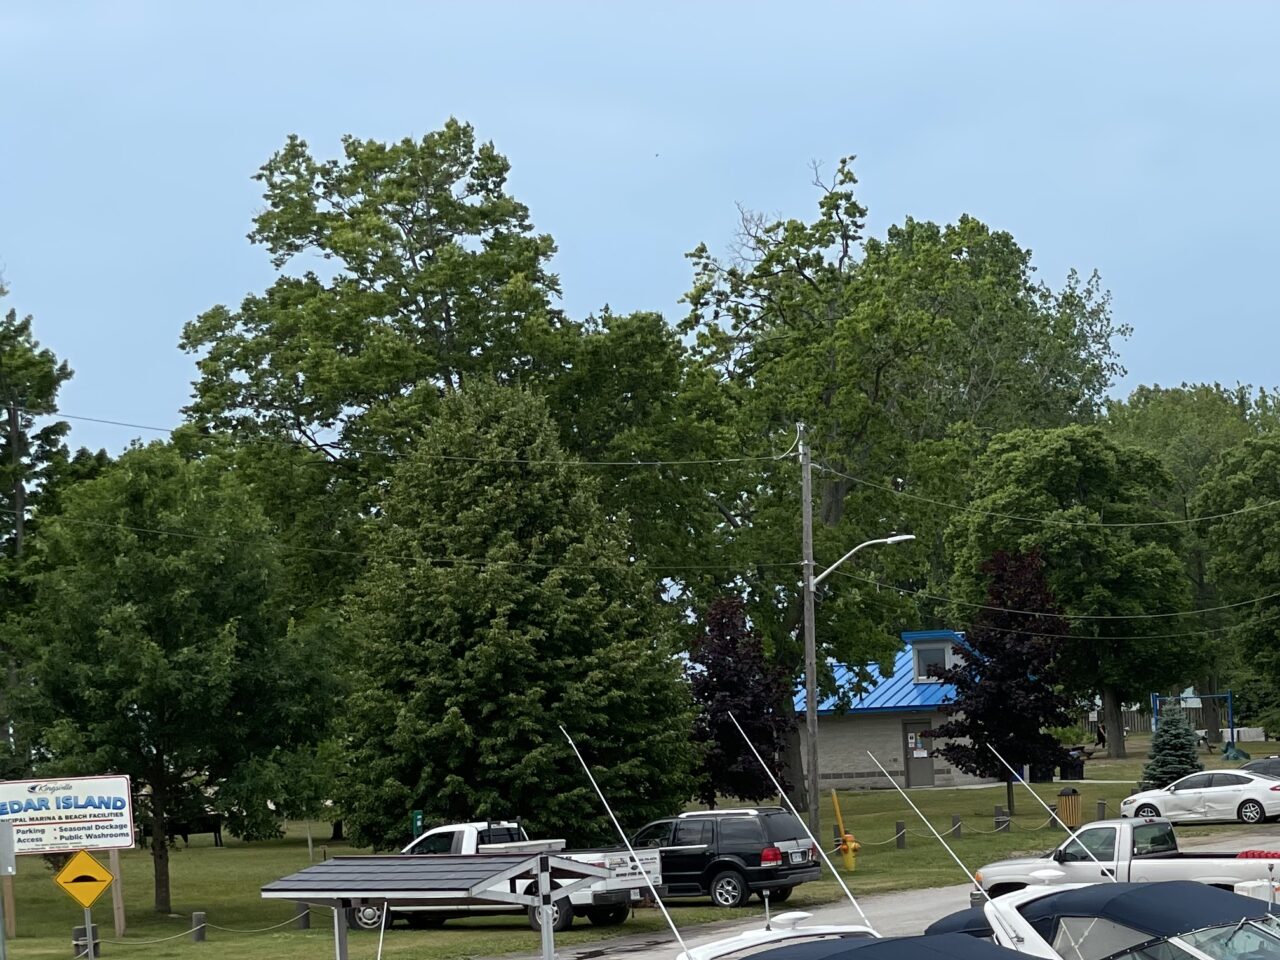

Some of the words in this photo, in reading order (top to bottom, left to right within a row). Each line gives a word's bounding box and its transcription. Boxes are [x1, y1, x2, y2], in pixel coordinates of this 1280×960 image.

[0, 797, 50, 815] EDAR
[55, 795, 126, 810] ISLAND
[95, 823, 128, 831] Dockage
[85, 831, 130, 840] Washrooms
